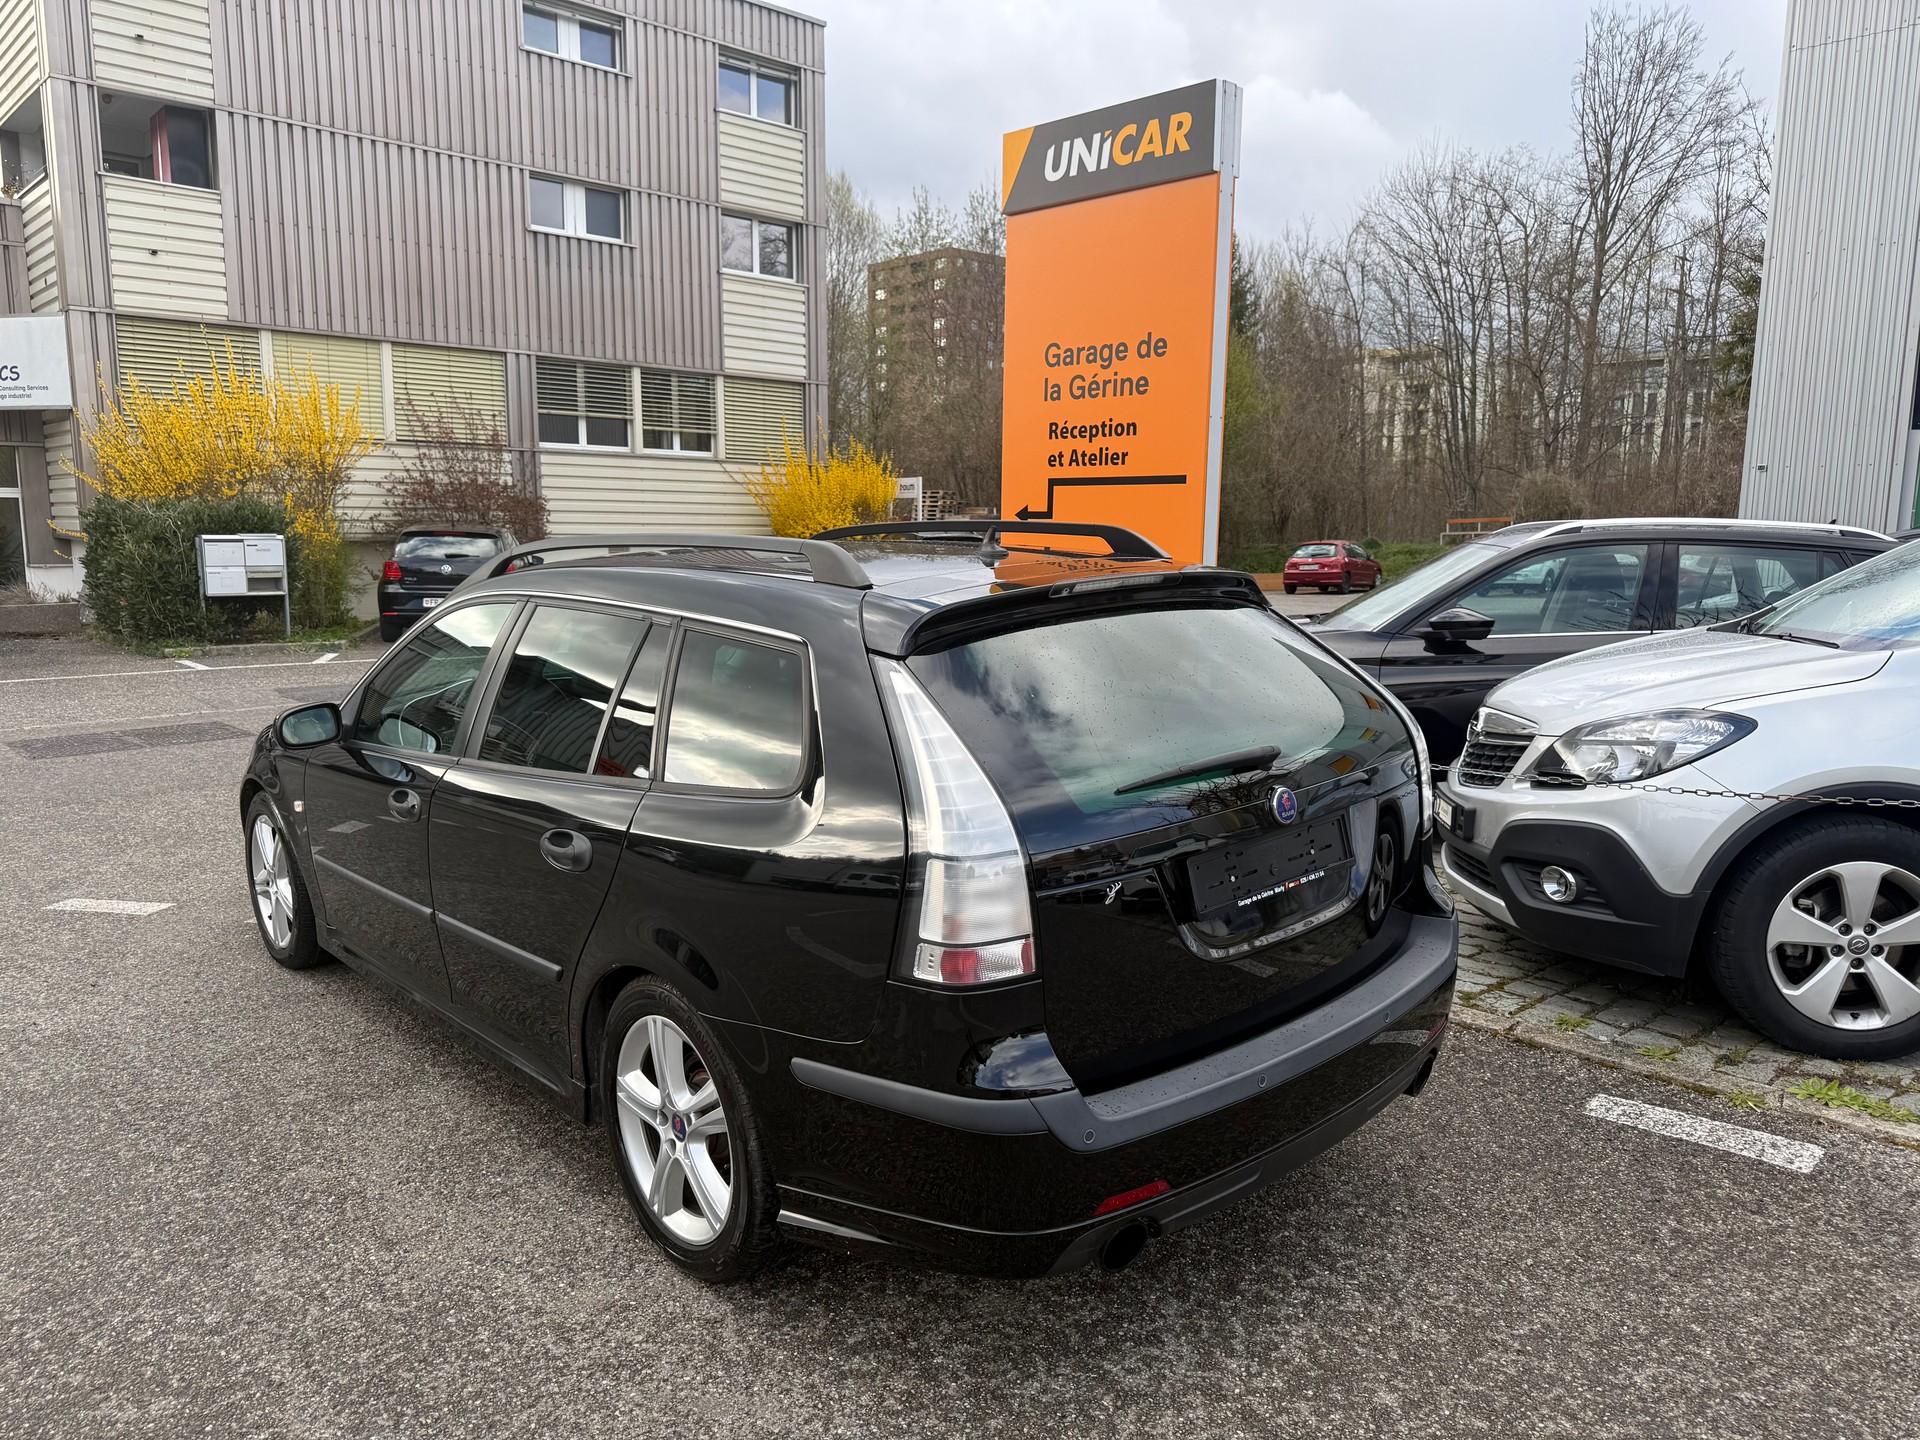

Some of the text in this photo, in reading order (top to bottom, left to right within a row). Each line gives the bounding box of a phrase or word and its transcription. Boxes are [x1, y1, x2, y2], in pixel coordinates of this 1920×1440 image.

[1044, 332, 1168, 370] Garage de
[1043, 371, 1149, 402] la Gérine
[1048, 417, 1138, 443] Réception
[1047, 447, 1129, 468] et Atelier
[1281, 810, 1295, 818] SAAB
[1237, 898, 1252, 907] Garage
